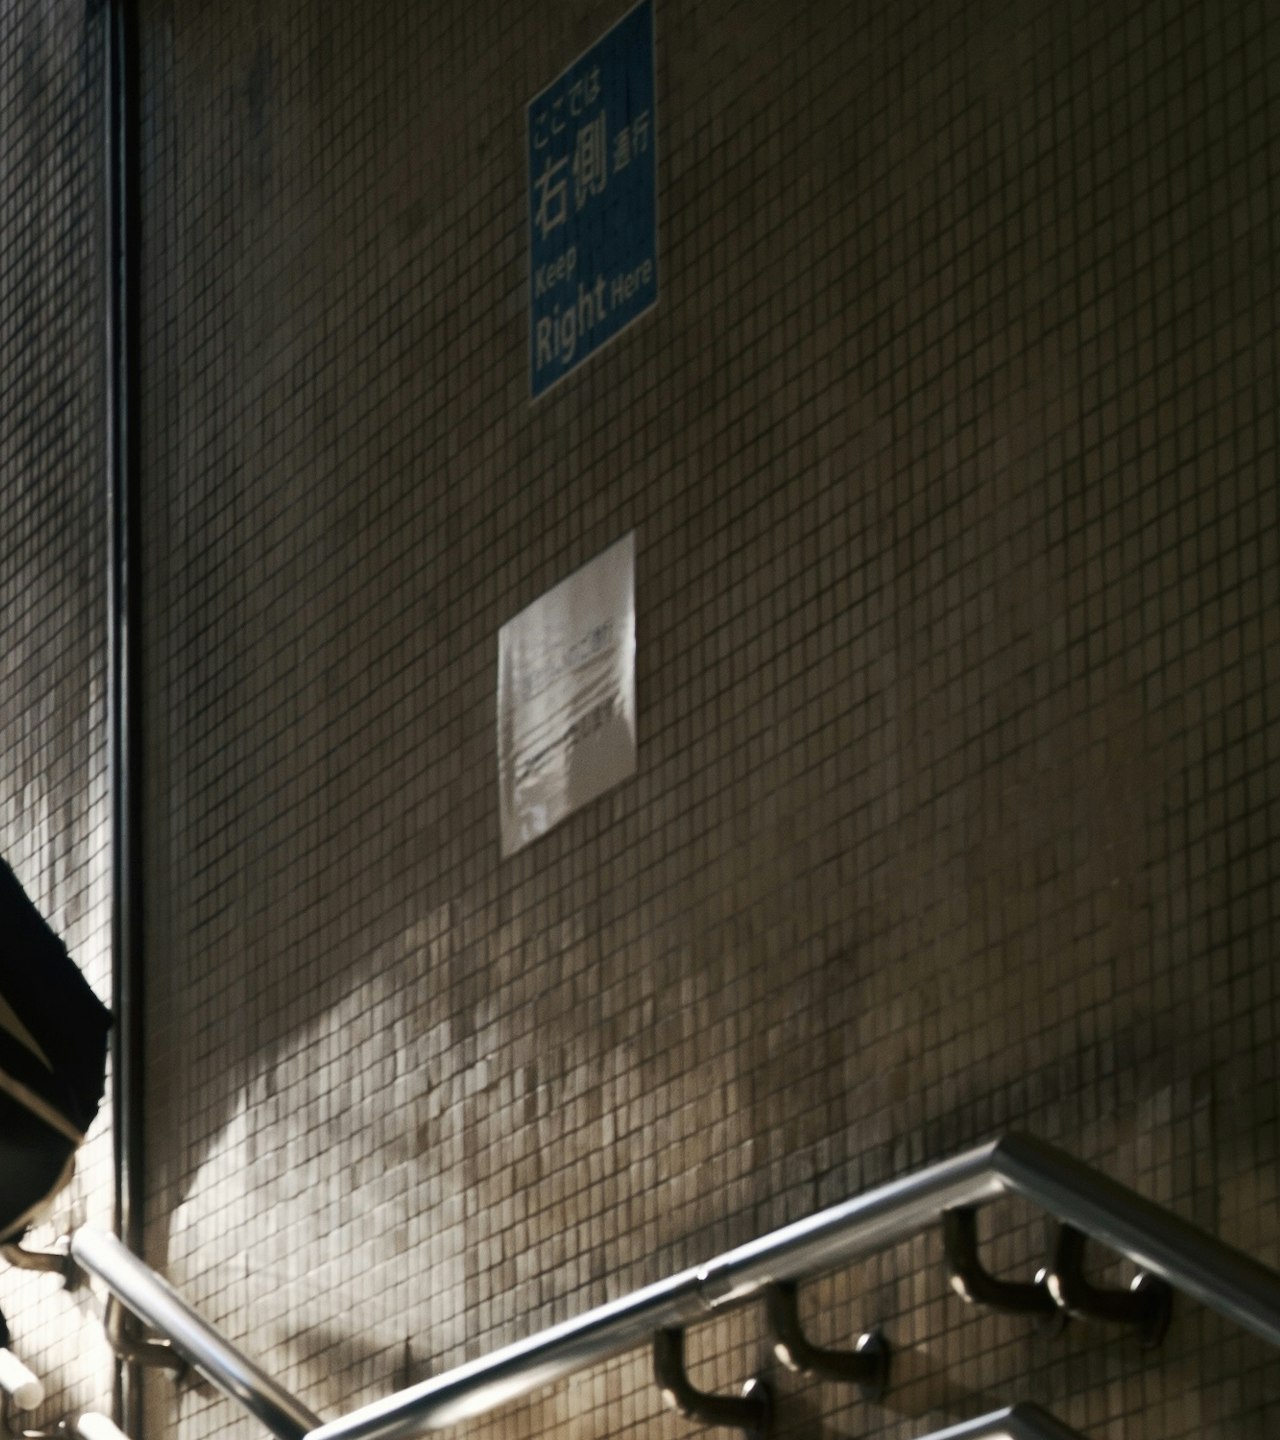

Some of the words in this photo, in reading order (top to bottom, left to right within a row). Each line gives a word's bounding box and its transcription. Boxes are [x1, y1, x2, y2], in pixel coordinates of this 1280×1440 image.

[534, 65, 601, 150] ここでは
[534, 107, 607, 241] 右側
[535, 245, 578, 300] Keep
[535, 273, 607, 371] Right
[610, 258, 652, 311] Here
